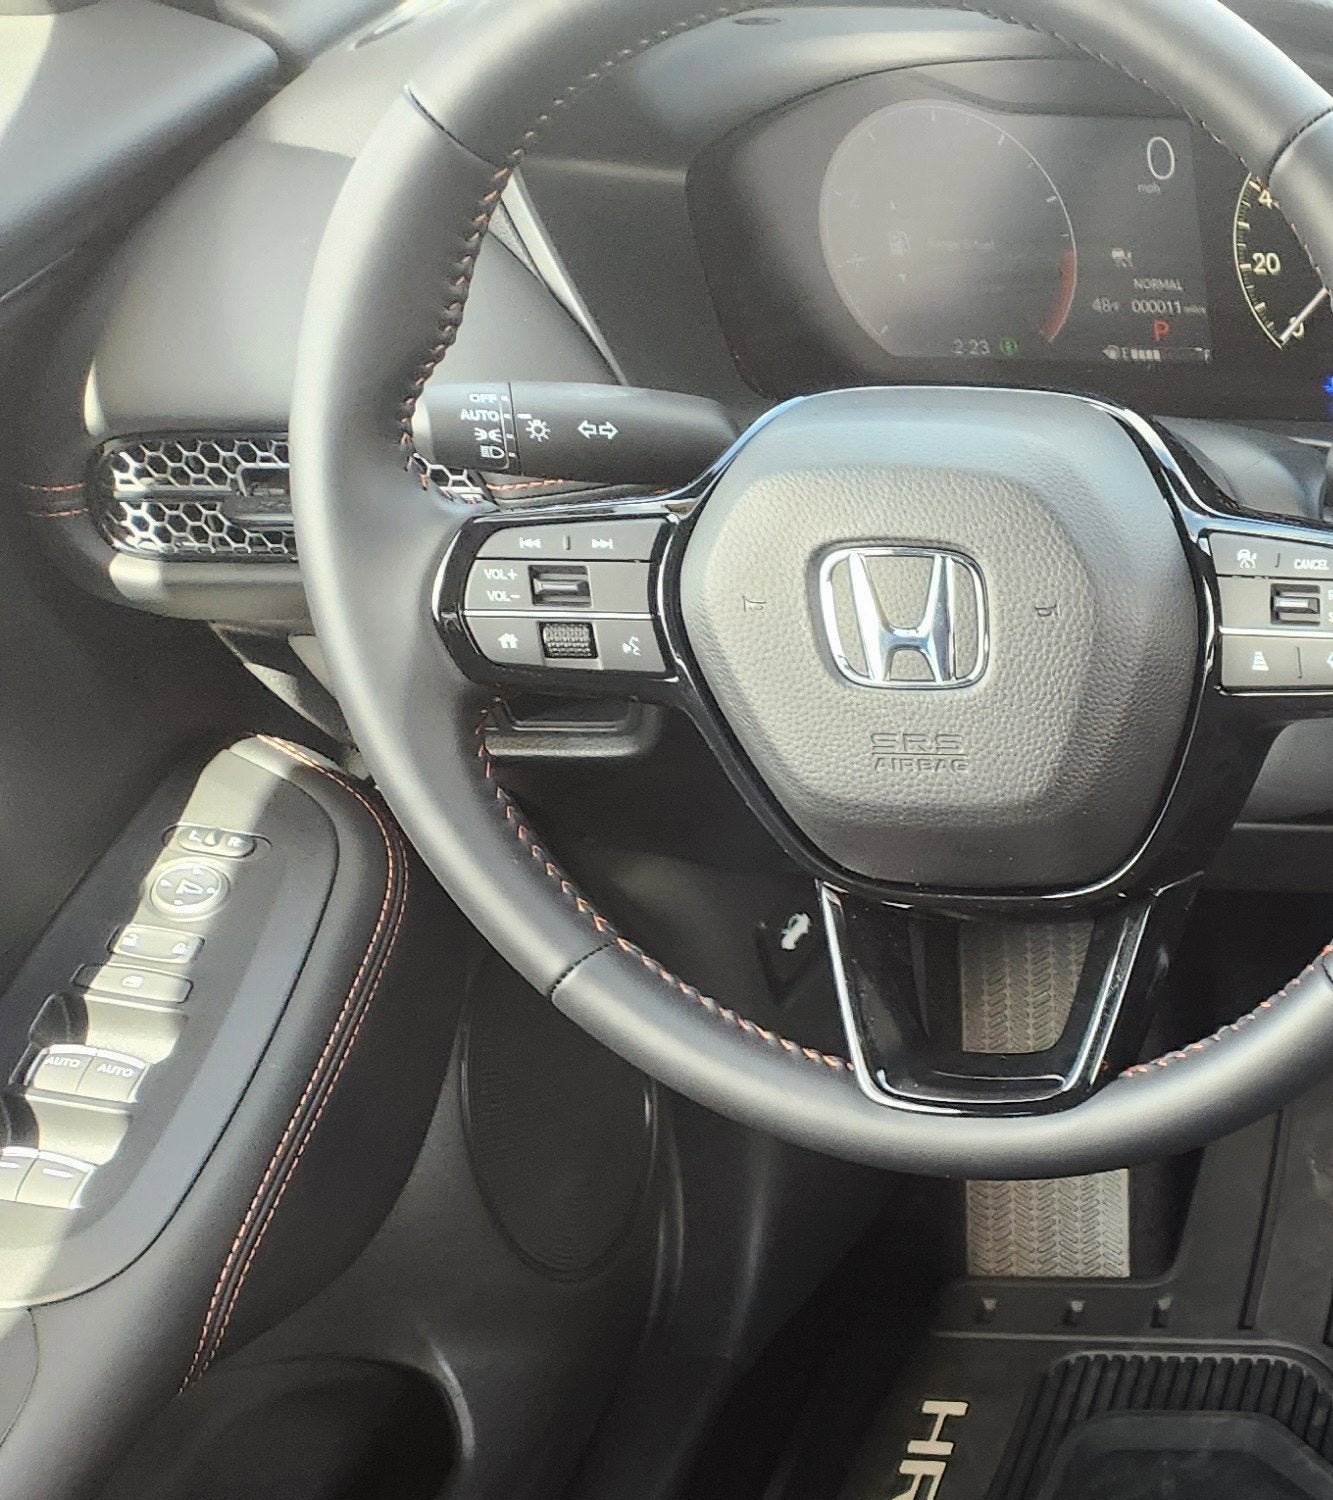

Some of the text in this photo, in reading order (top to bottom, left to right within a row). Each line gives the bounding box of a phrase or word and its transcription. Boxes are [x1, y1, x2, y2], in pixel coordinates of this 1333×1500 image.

[1147, 137, 1175, 180] 0
[1138, 183, 1161, 194] mph
[1252, 253, 1281, 275] 20
[1133, 278, 1184, 291] NORMAL
[1131, 299, 1181, 315] 000011
[1152, 319, 1170, 341] P
[469, 393, 498, 403] OFF
[461, 408, 499, 421] AUTO
[1293, 558, 1330, 571] CANCEL
[870, 732, 964, 751] SRS
[874, 757, 969, 773] AIRBAG
[45, 1056, 81, 1068] AUTO
[96, 1063, 134, 1078] AUTO
